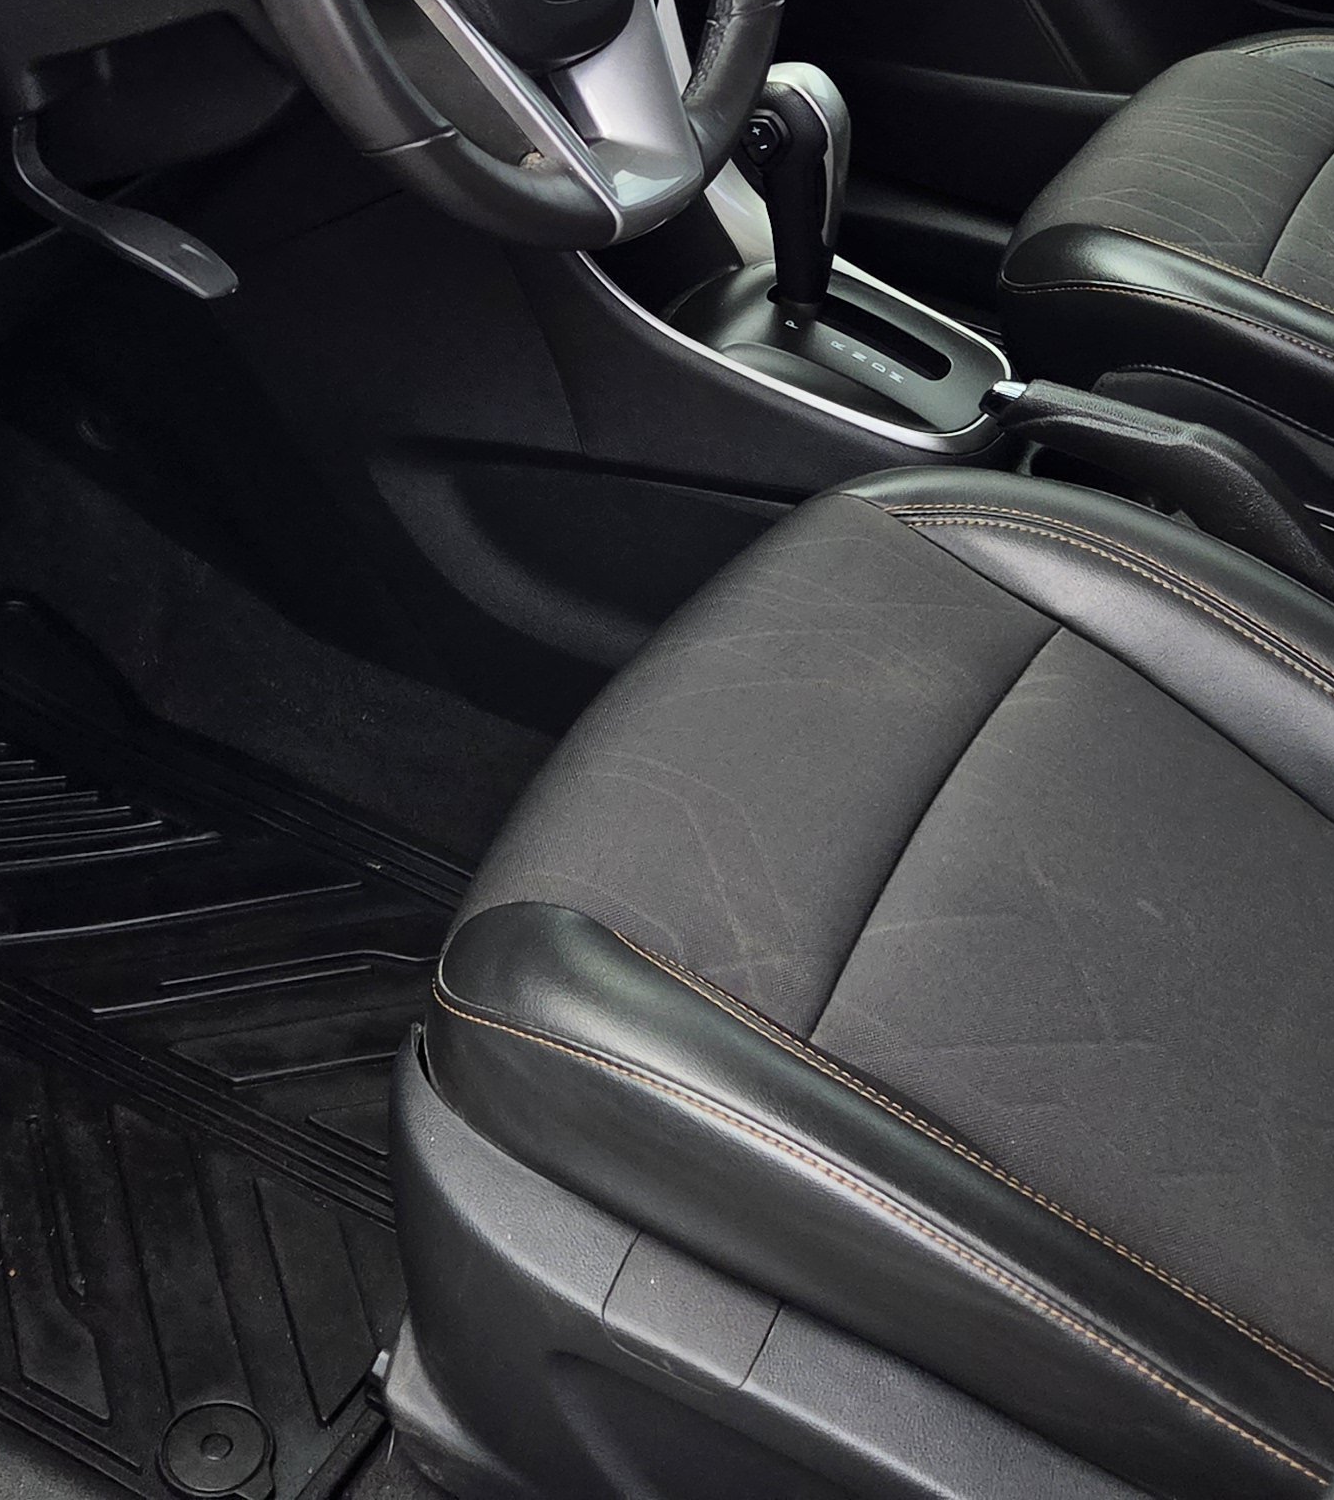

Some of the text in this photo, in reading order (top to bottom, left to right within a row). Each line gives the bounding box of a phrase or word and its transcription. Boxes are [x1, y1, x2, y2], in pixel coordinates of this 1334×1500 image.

[785, 320, 905, 383] P R N D M
